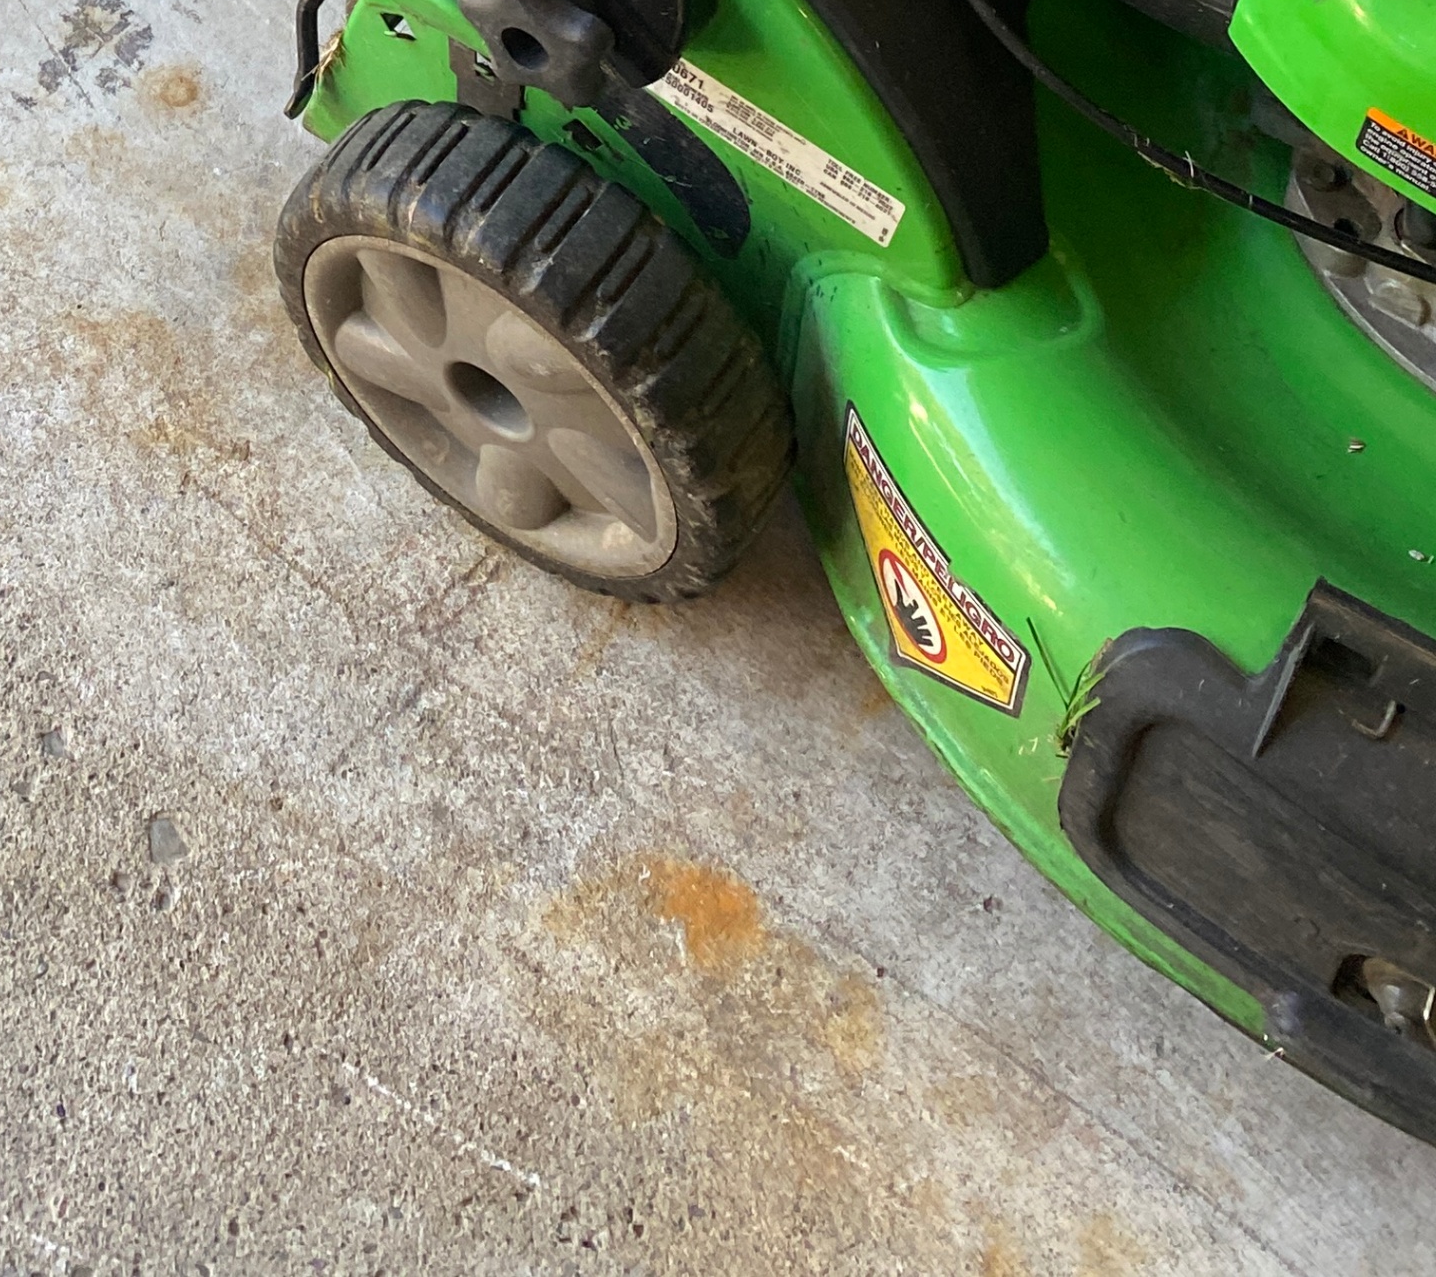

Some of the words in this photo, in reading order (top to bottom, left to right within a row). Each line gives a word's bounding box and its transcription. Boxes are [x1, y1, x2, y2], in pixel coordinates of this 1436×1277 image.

[1370, 122, 1380, 130] To
[1382, 130, 1405, 146] avoid
[851, 423, 1015, 663] DANGER/PELIGRO
[956, 613, 982, 645] AWAY
